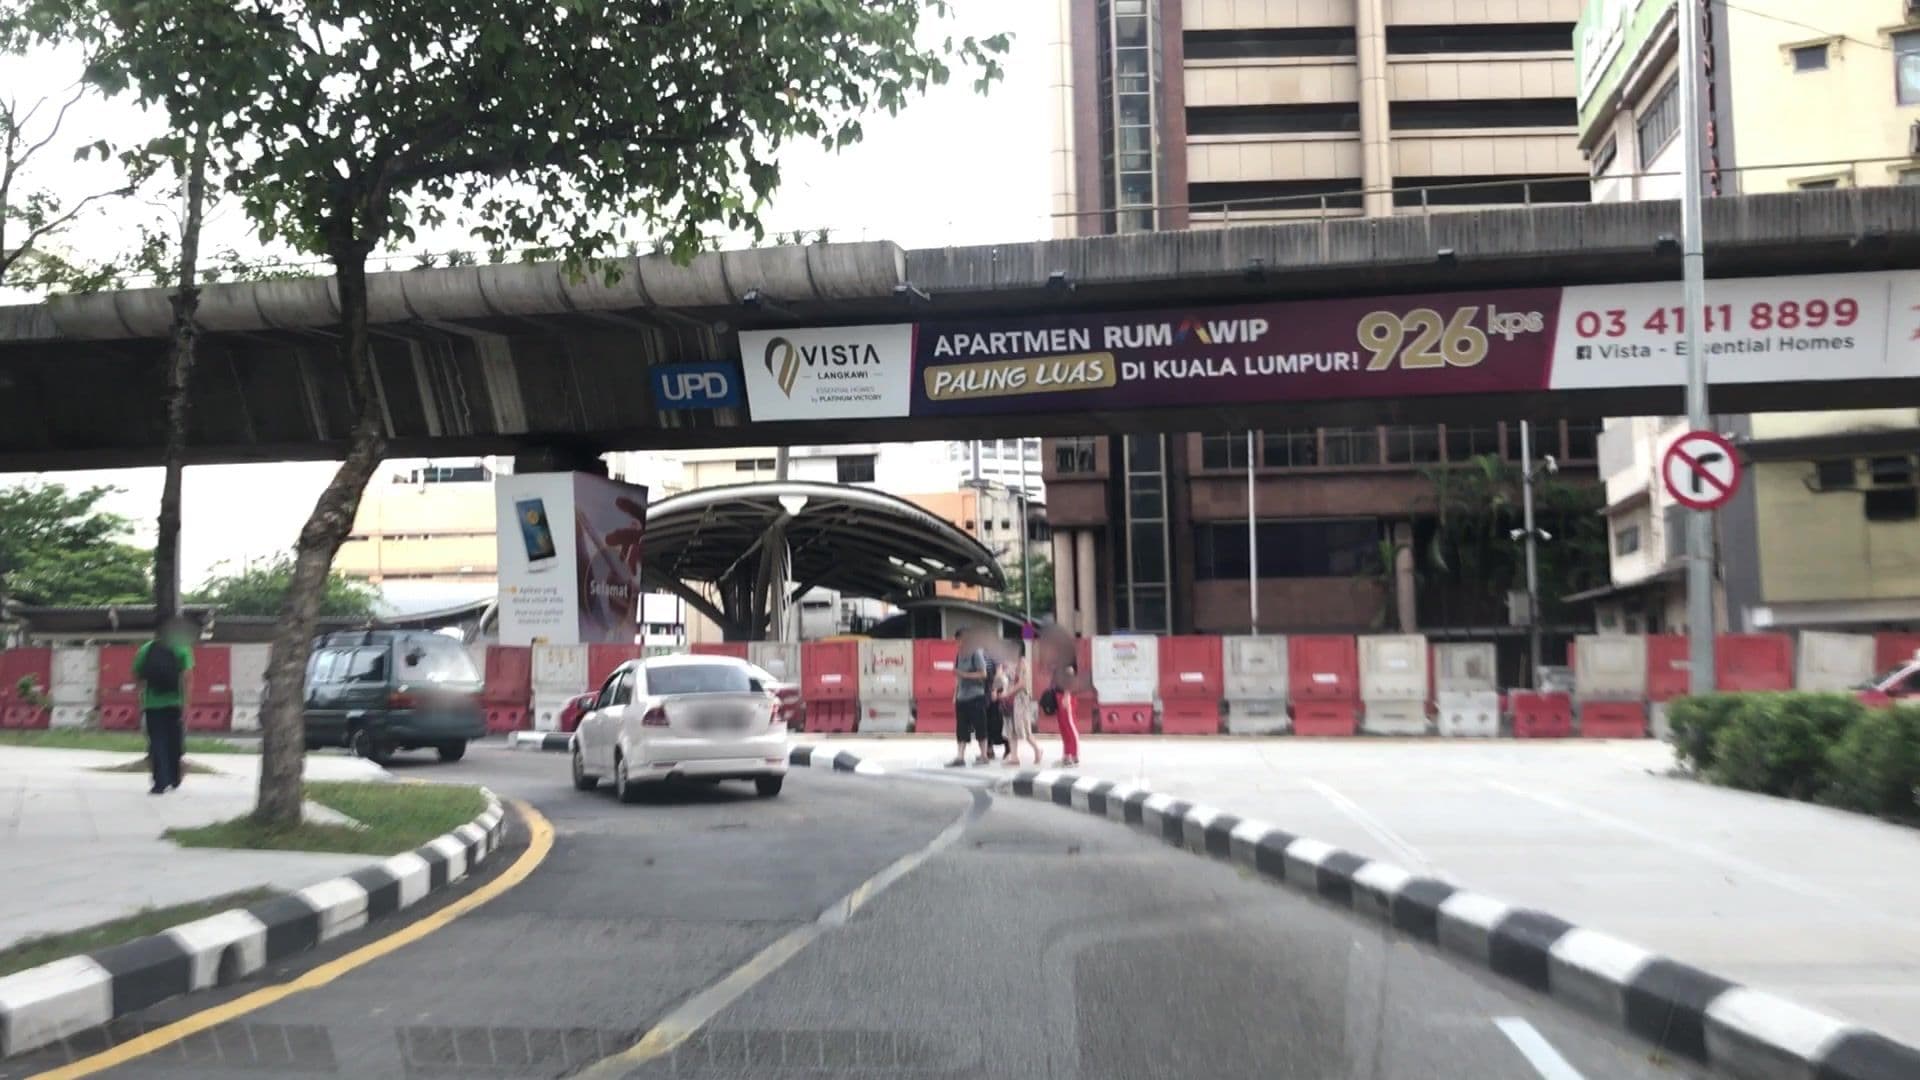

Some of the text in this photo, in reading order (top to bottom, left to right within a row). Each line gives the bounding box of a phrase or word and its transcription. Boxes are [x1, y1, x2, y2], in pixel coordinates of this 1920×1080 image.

[1575, 309, 1628, 338] 03
[1750, 298, 1860, 331] 8899
[933, 328, 1091, 357] APARTMEN
[1357, 304, 1545, 371] 926 kps
[1600, 343, 1652, 359] Vista
[1675, 337, 1771, 357] Eential
[1779, 334, 1856, 352] Homes
[800, 343, 881, 366] VISTA
[1121, 351, 1360, 381] DI KUALA LUMPUR!
[661, 372, 729, 401] UPD
[817, 371, 869, 380] LANGKAWI
[933, 360, 1104, 395] PALING LUAS
[819, 395, 852, 403] PLATINUM
